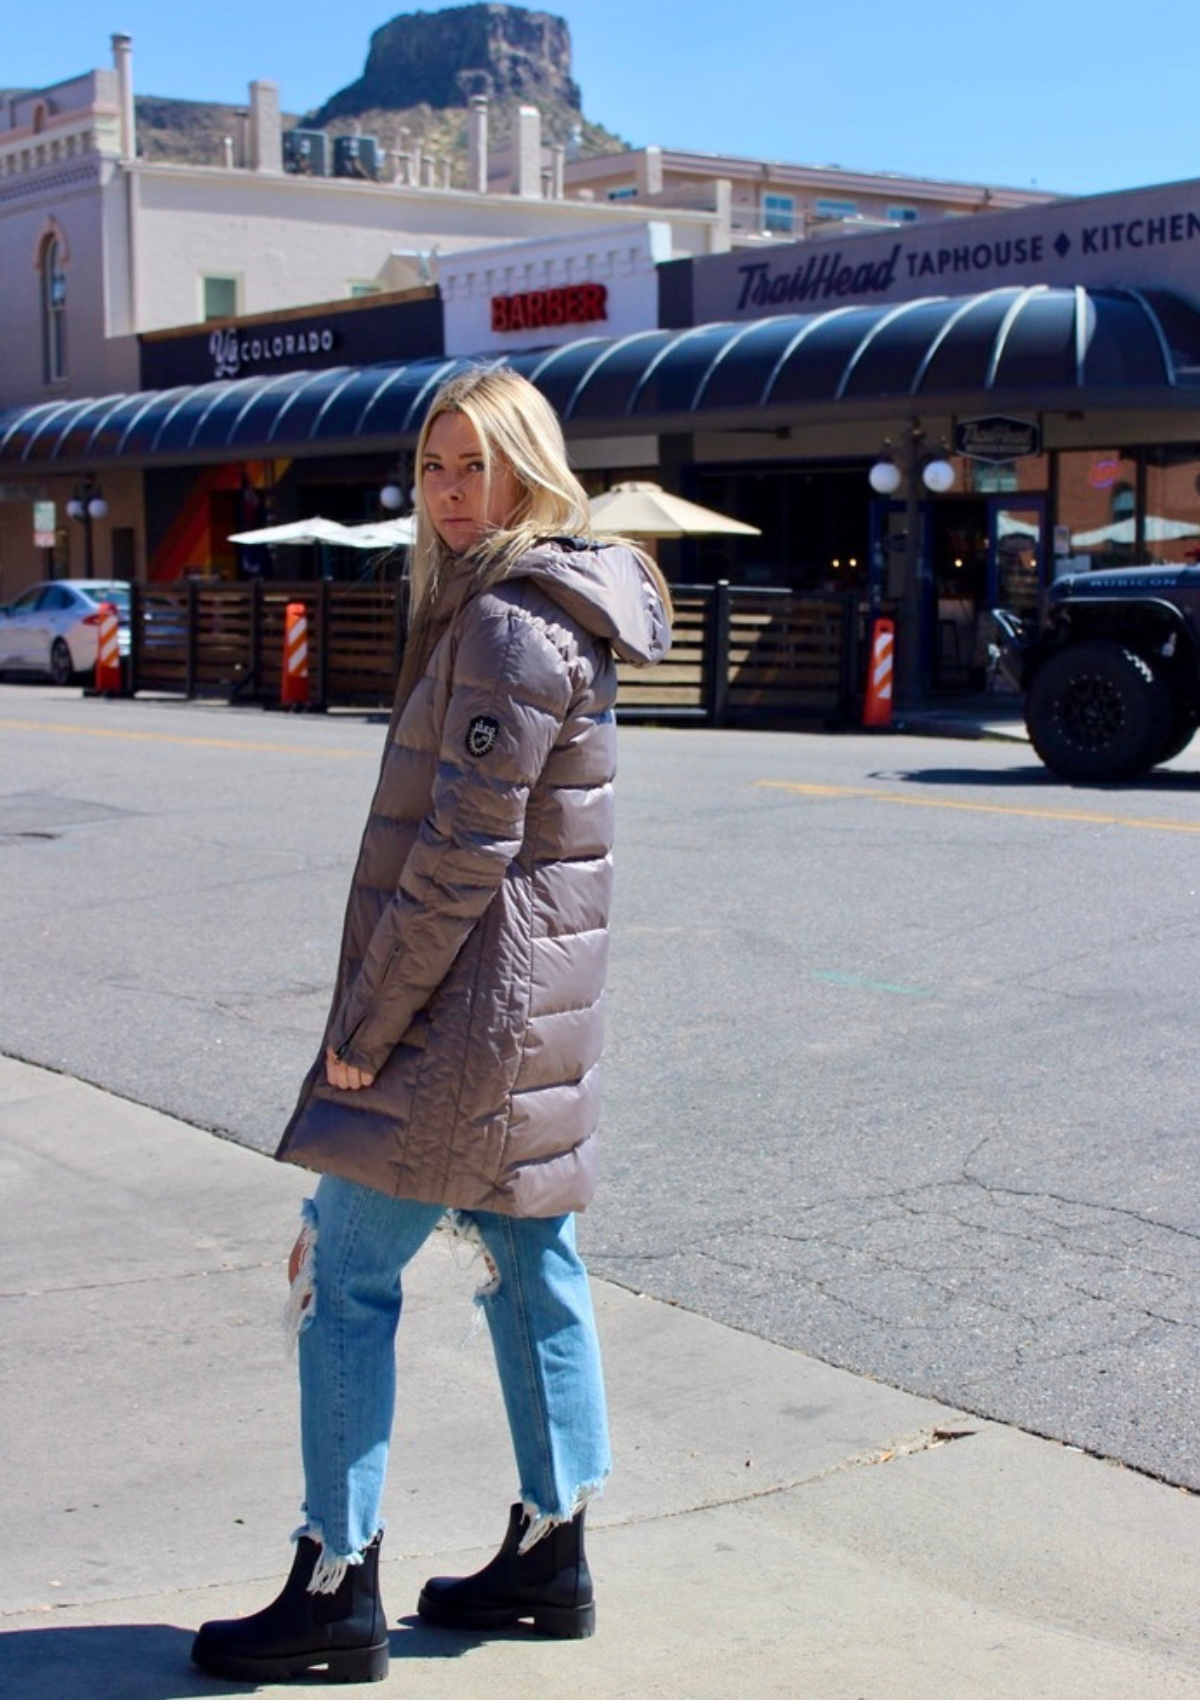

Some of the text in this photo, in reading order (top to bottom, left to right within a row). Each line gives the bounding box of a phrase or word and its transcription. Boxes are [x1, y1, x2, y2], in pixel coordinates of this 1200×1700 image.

[737, 244, 901, 311] TrailHead
[906, 236, 1044, 278] TAPHOUSE
[491, 283, 606, 332] BARBER
[241, 329, 333, 361] COLORADO
[1089, 578, 1177, 588] RUBICON
